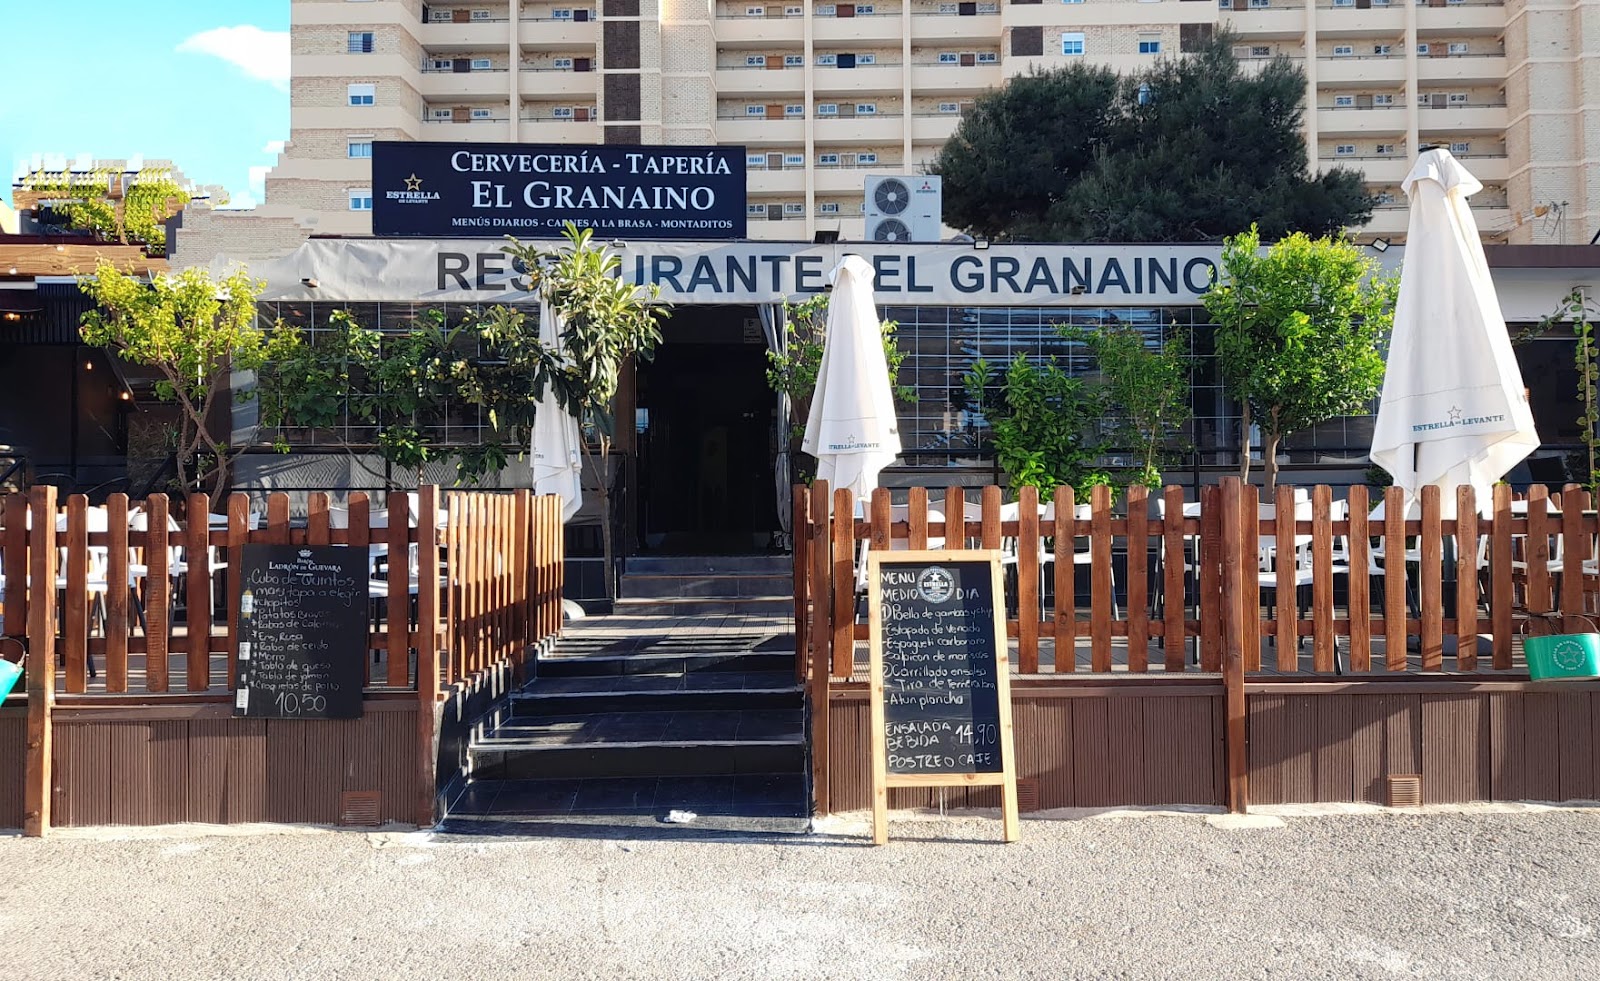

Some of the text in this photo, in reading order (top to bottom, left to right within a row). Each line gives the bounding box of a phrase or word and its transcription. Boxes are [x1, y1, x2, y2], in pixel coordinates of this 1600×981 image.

[451, 150, 731, 175] CERVECERÍA TAPERÍA
[386, 191, 440, 199] ESTRELLA
[471, 180, 715, 211] EL GRANAINO
[452, 216, 490, 227] MENÚS
[493, 218, 539, 227] DIARIOS
[592, 219, 599, 227] A
[602, 219, 615, 228] LA
[618, 219, 652, 228] BRASA
[661, 219, 733, 229] MONTADITOS
[437, 252, 1218, 294] RESURANTE EL GRANAINO
[1412, 420, 1454, 432] ESTRELLA
[1462, 415, 1505, 426] LEVANTE
[880, 572, 916, 585] MENU
[880, 588, 980, 602] MEDIO DIA
[885, 721, 952, 737] ENSALADA
[886, 734, 940, 751] BEBIDA
